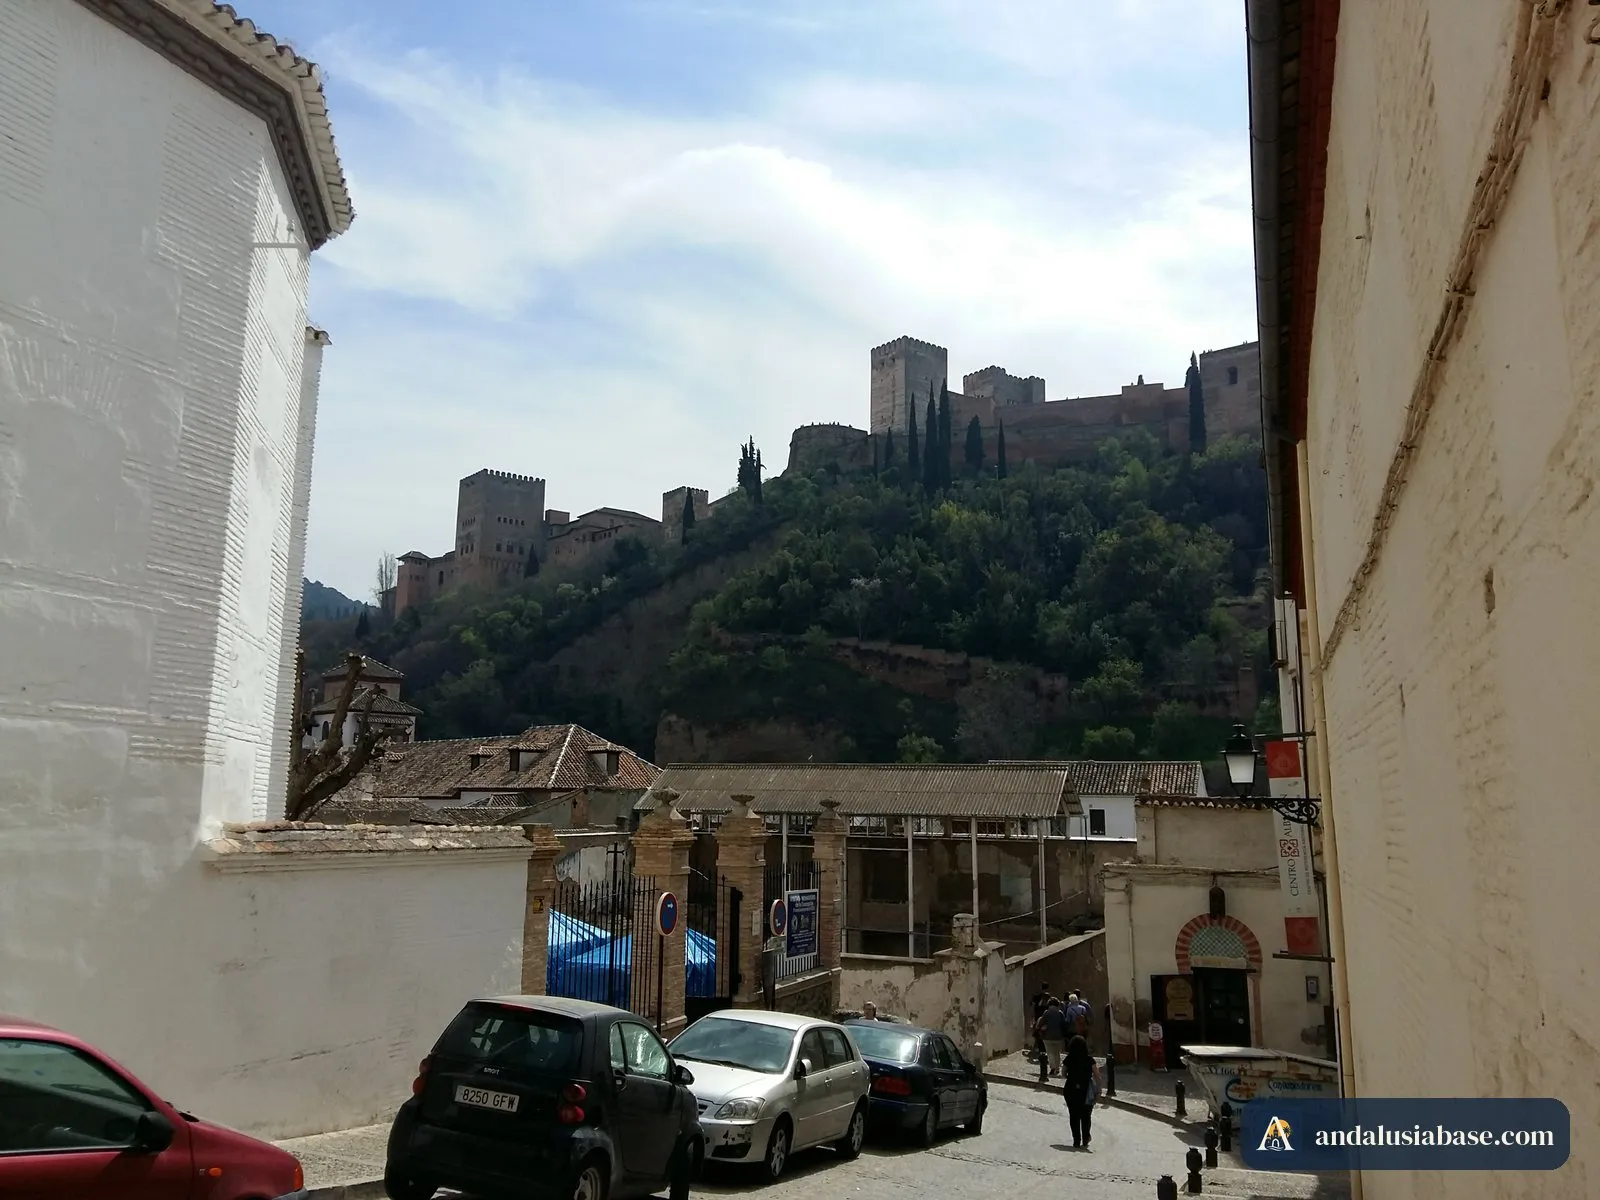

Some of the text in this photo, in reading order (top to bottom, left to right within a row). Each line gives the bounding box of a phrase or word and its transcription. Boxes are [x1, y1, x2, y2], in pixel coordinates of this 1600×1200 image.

[1287, 858, 1299, 897] CENTRO
[463, 1089, 516, 1109] 8250 GFW
